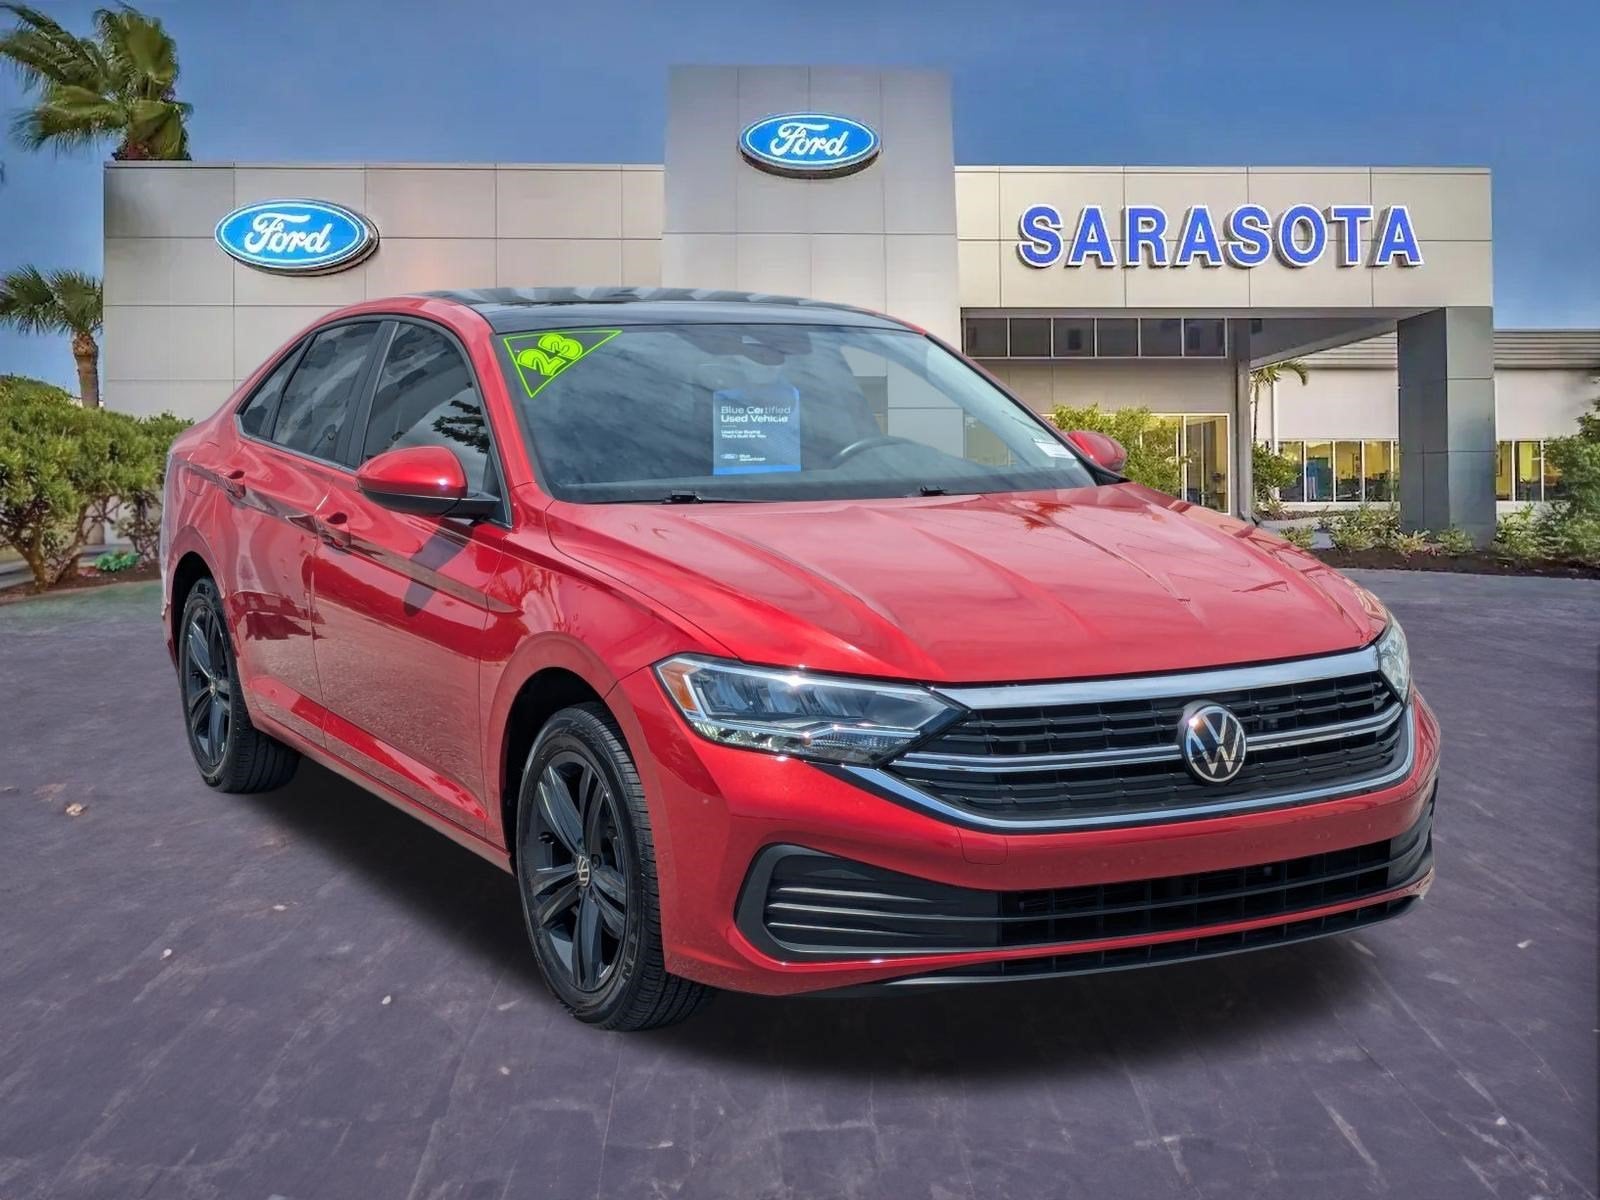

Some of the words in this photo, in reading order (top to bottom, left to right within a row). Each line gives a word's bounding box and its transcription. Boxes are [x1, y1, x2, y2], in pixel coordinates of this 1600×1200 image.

[770, 122, 849, 157] Ford
[244, 212, 333, 254] Ford
[1017, 204, 1424, 267] SARASOTA
[517, 333, 583, 376] 23
[720, 406, 745, 414] Blue
[746, 406, 791, 414] Certified
[720, 415, 748, 423] Used
[750, 415, 788, 423] Vehicle
